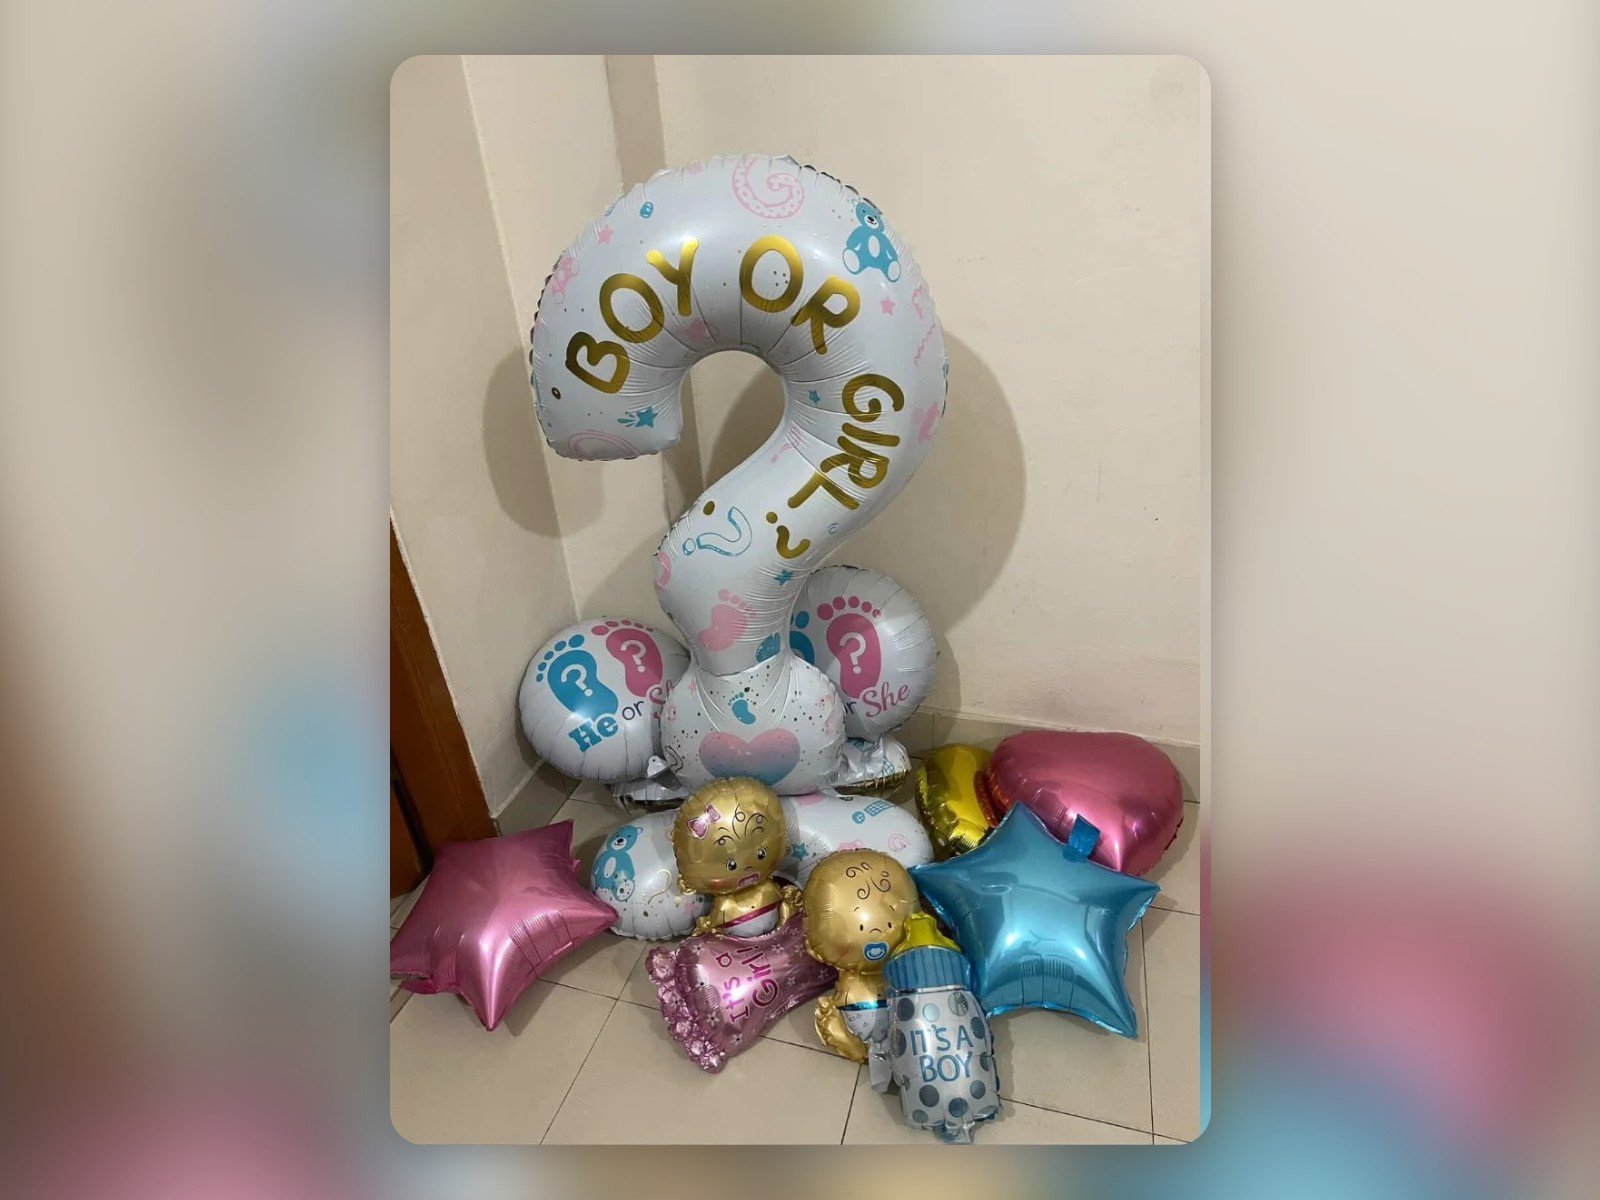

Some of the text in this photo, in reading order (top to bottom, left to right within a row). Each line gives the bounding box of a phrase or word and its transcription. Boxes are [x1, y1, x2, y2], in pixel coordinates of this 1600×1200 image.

[565, 237, 698, 394] BOY
[739, 235, 860, 355] OR
[844, 681, 910, 718] r She
[568, 701, 644, 752] He or
[716, 952, 749, 1022] It's a
[736, 946, 778, 1007] Girl!
[910, 1023, 974, 1056] IT'S A
[919, 1051, 973, 1082] BOY
